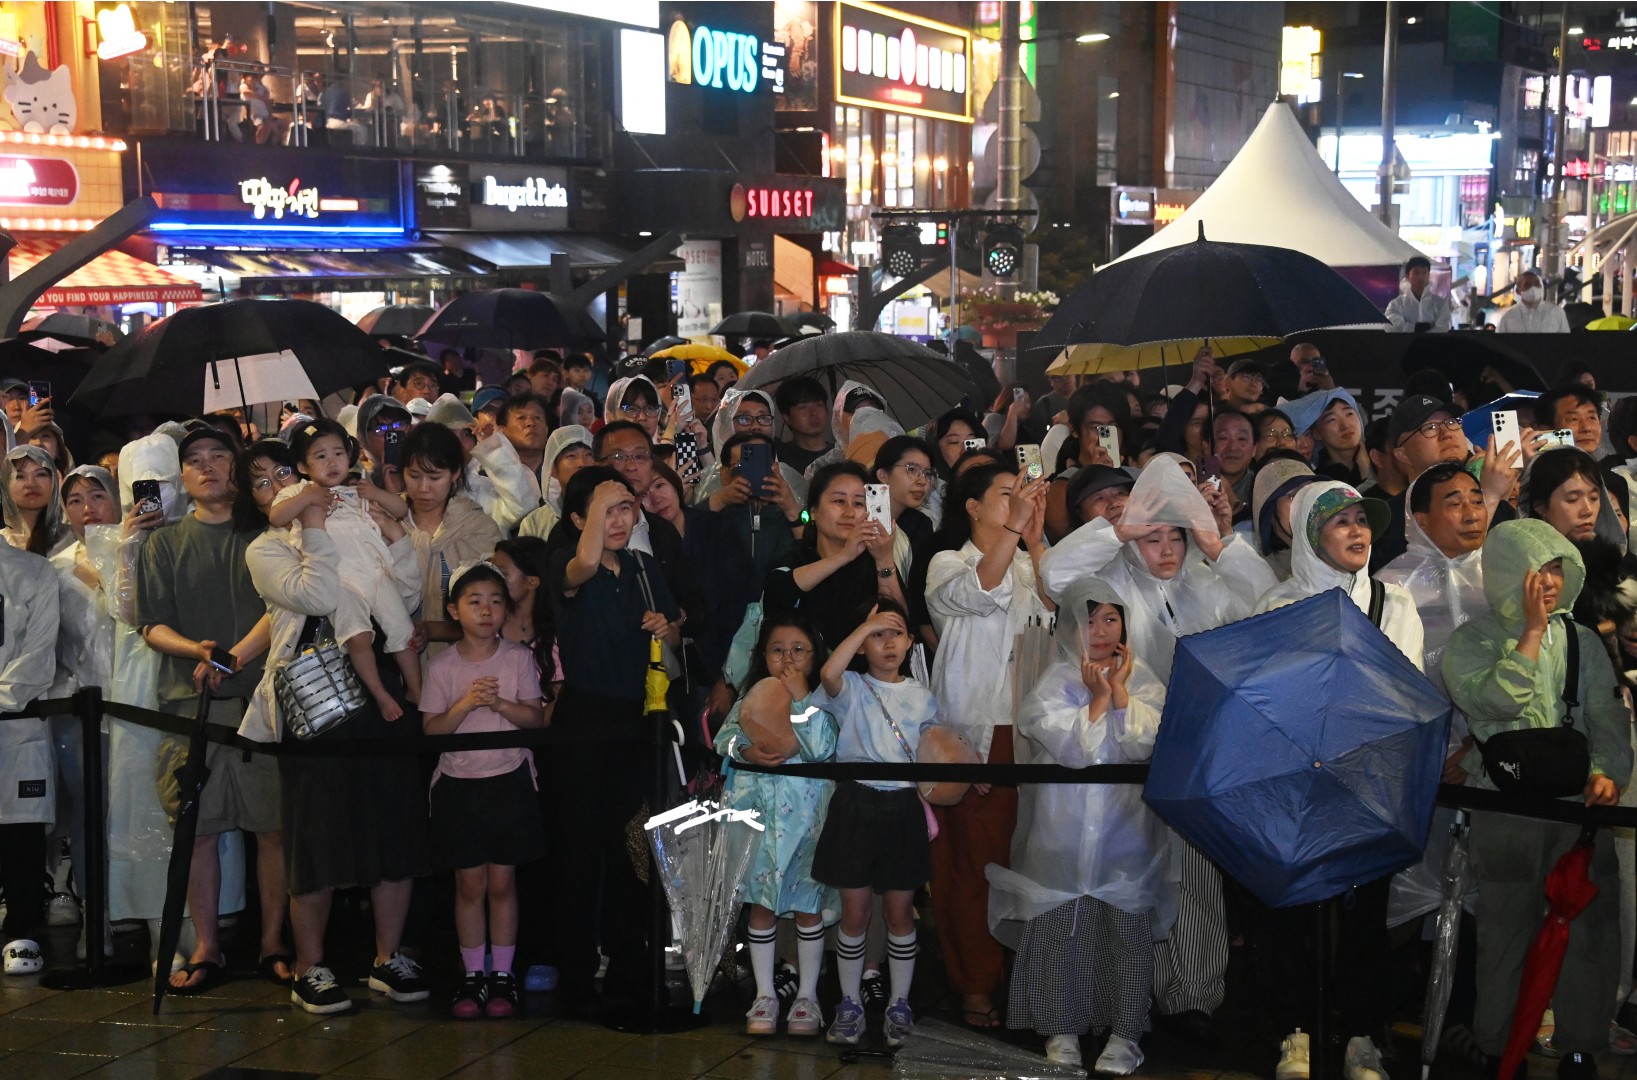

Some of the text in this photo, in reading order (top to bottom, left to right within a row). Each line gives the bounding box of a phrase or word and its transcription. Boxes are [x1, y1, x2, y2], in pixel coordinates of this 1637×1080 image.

[692, 25, 758, 92] OPUS
[747, 189, 813, 217] SUNSET
[746, 250, 769, 267] HOTEL
[48, 293, 64, 303] YOU
[67, 292, 86, 302] FIND
[88, 291, 110, 302] YOUR
[113, 290, 159, 301] HAPPINESS?
